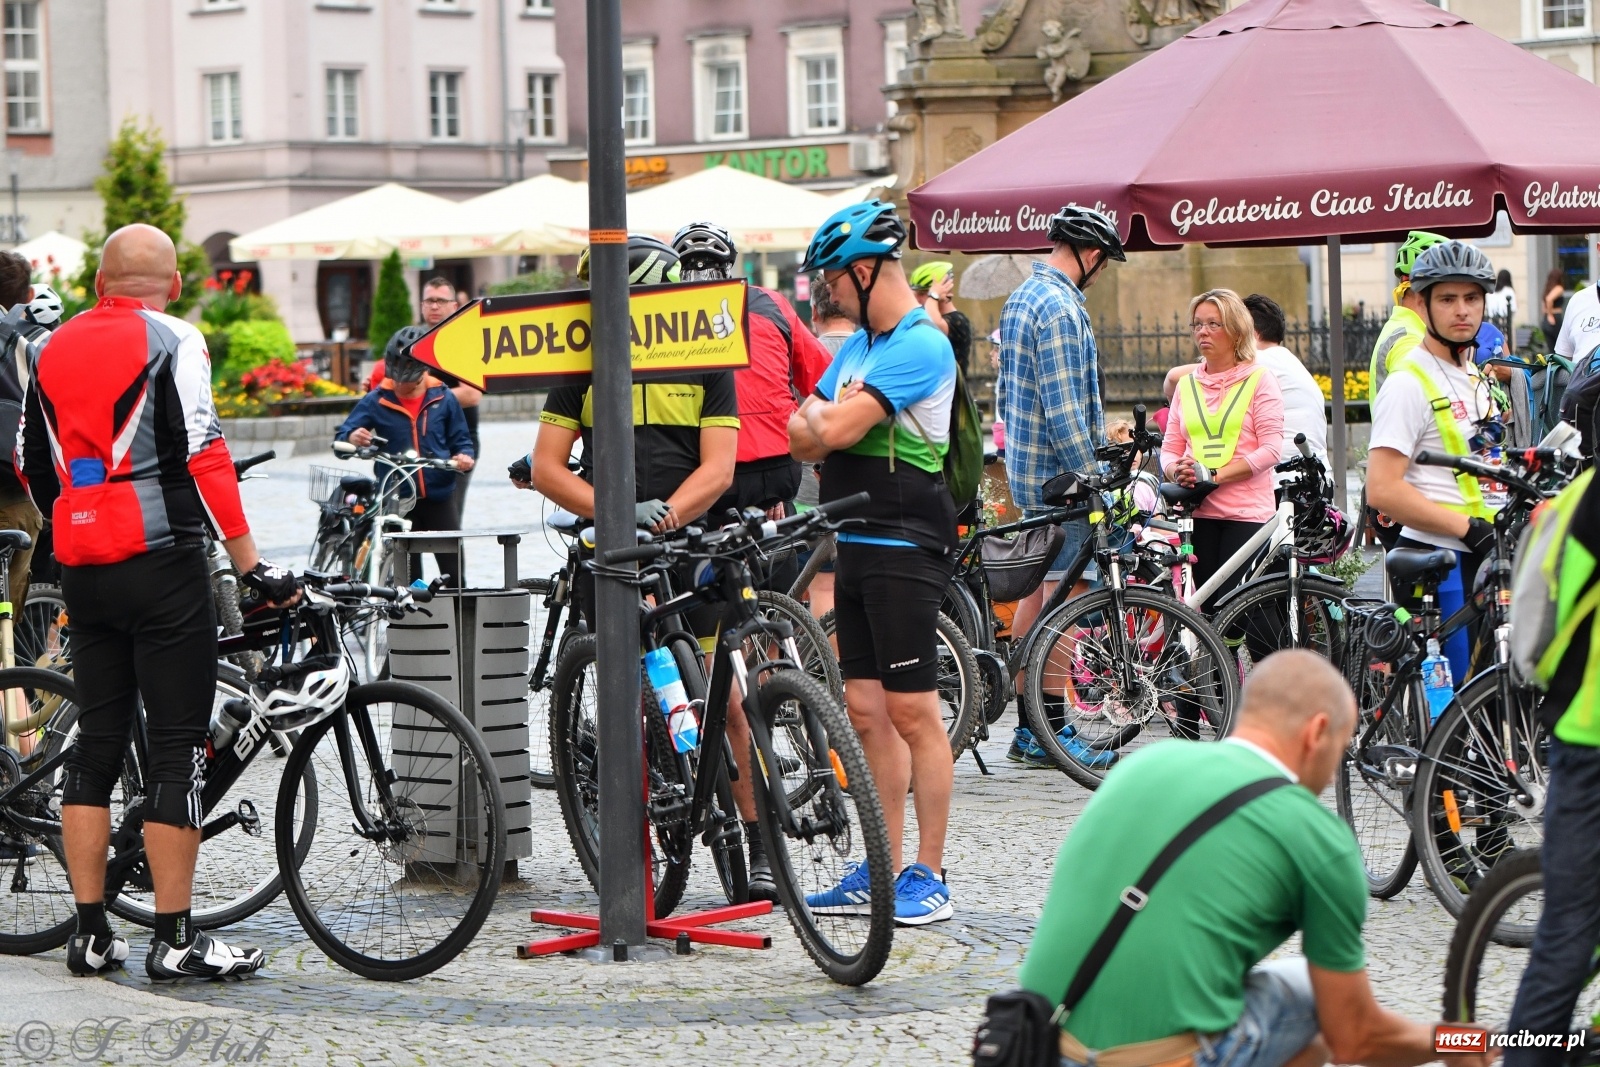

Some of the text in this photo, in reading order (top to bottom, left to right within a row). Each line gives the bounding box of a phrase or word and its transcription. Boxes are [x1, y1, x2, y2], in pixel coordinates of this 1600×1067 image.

[704, 147, 829, 178] KANTOR
[930, 209, 1012, 243] Gelateria
[1170, 180, 1474, 236] Gelateria Ciao Italia
[481, 309, 713, 364] JADŁOAJNIA
[646, 348, 685, 360] domowe
[685, 342, 733, 360] jedzenie!
[233, 714, 272, 762] BM
